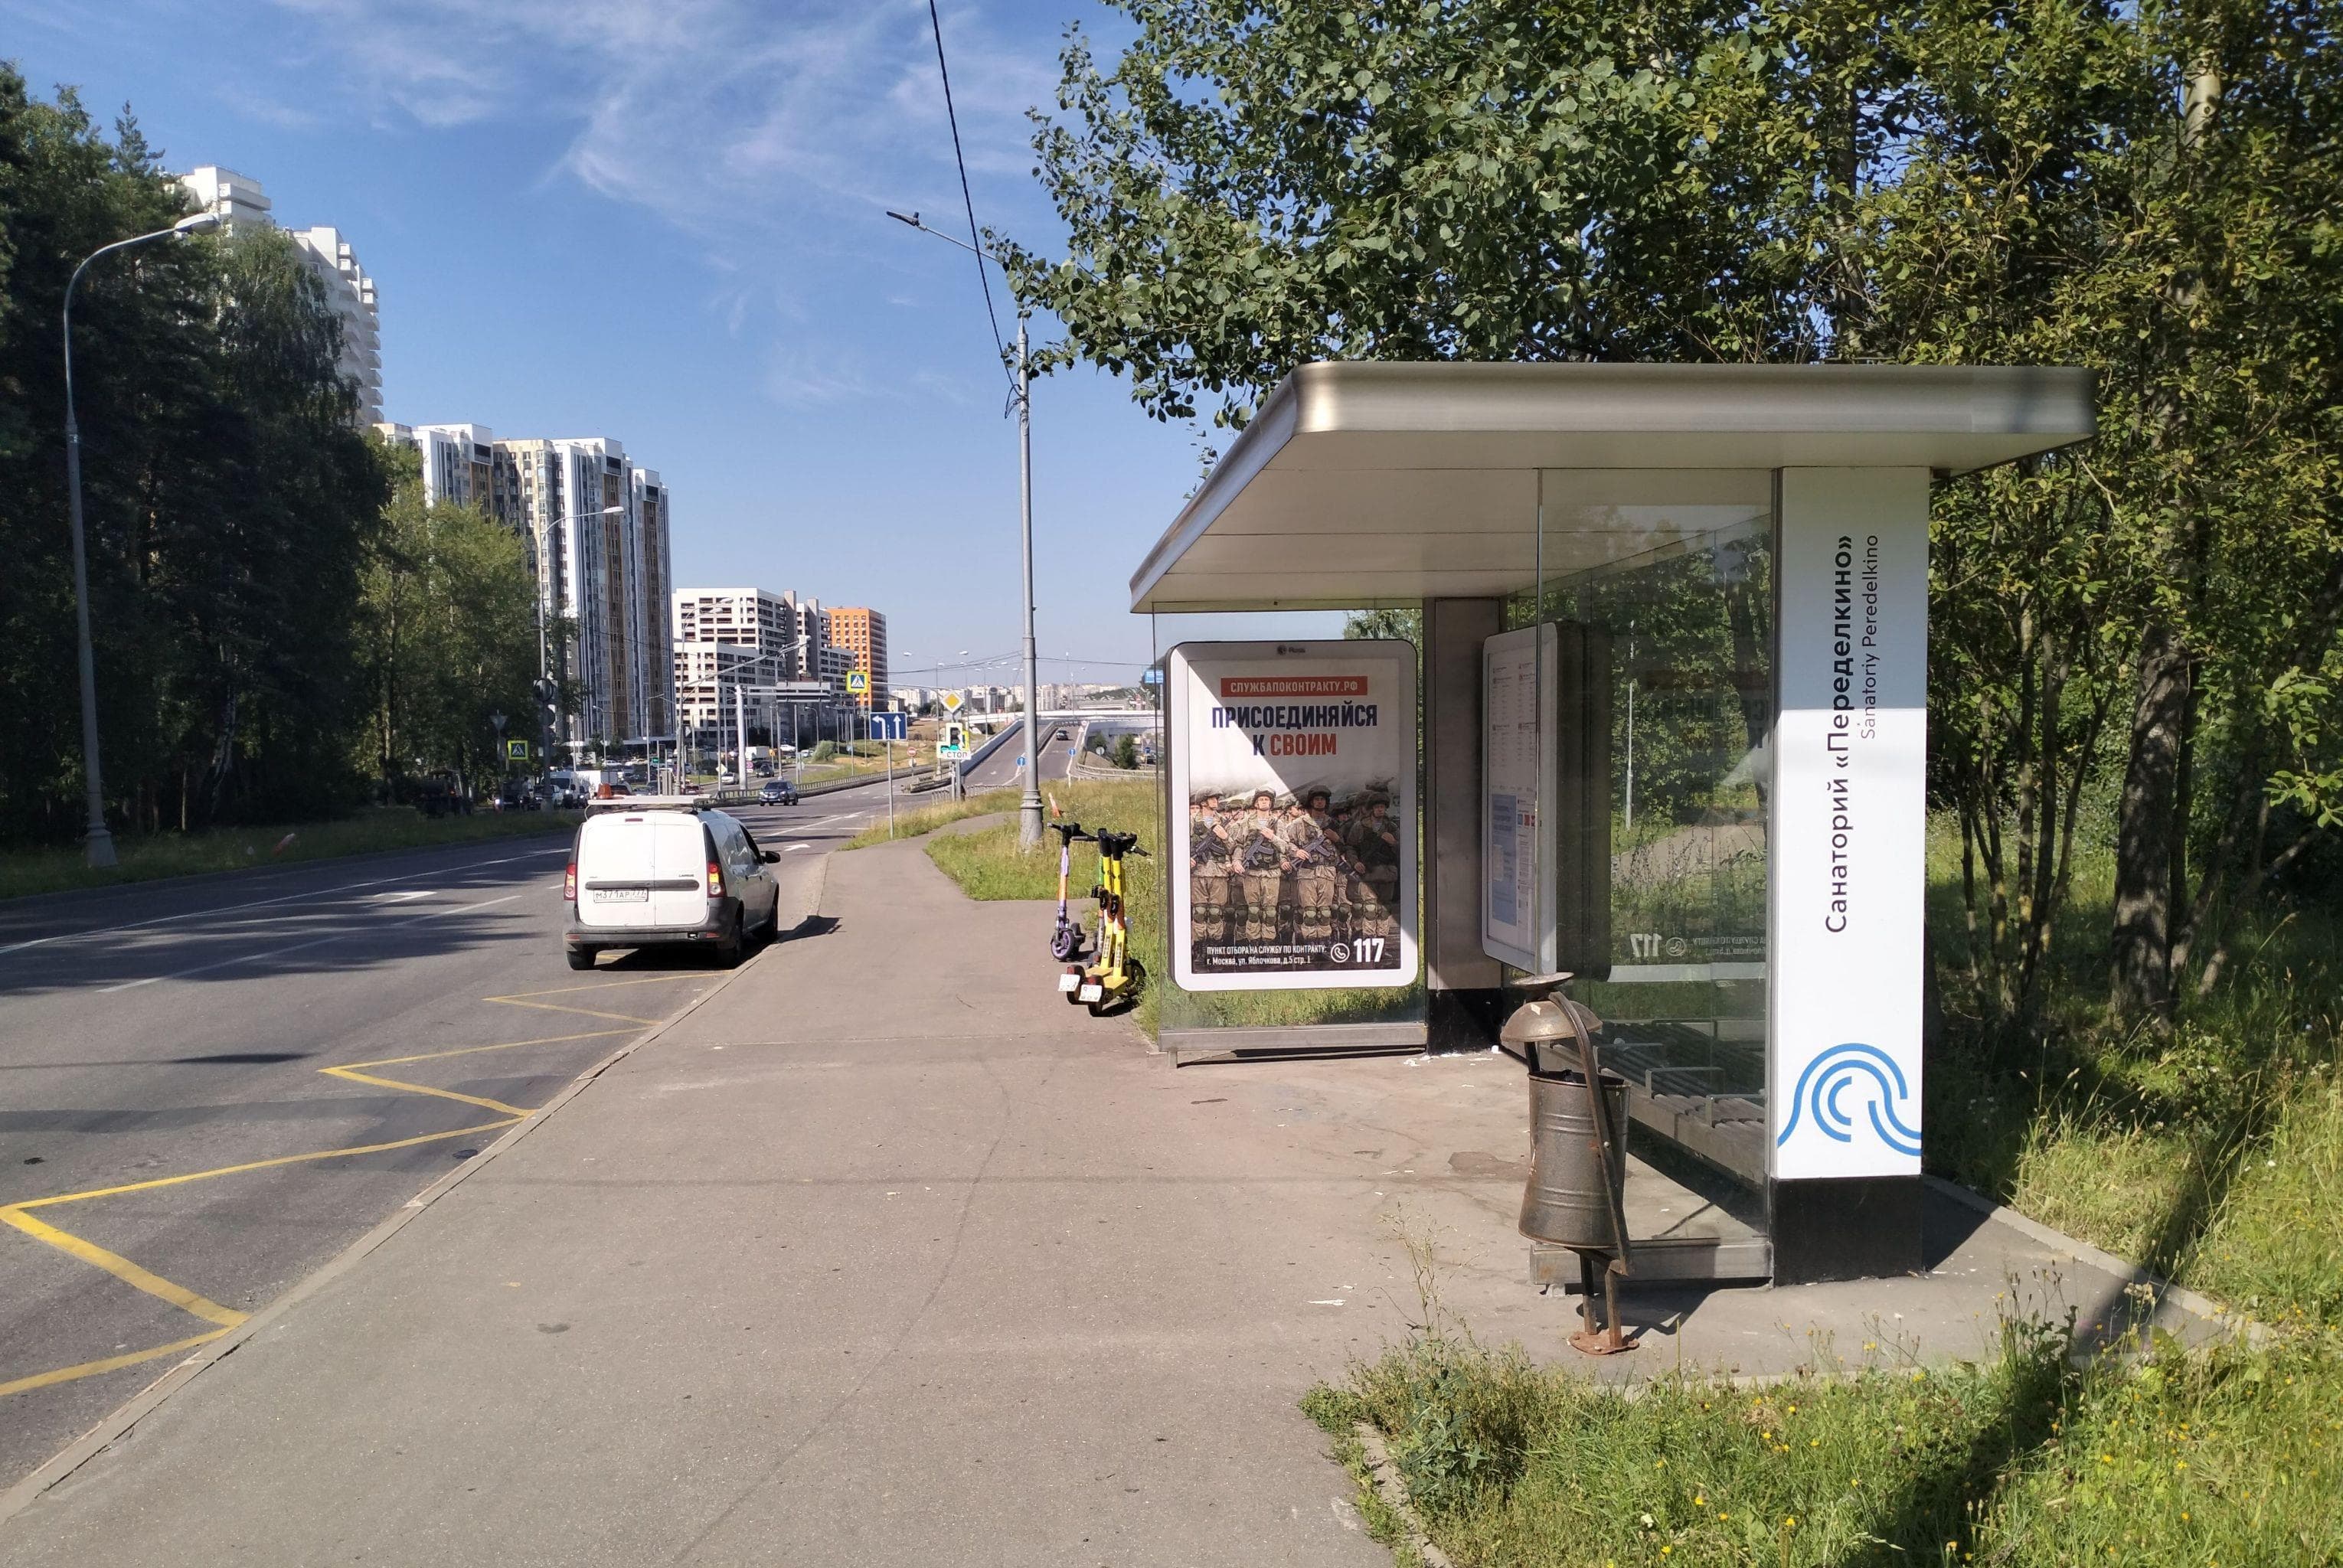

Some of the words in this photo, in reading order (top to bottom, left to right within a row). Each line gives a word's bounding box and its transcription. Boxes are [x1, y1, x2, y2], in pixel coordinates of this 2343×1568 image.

[1861, 535, 1878, 647] Peredelkino
[1827, 535, 1854, 768] «Переделкино»
[1230, 681, 1358, 693] СЛУЖБАПОКОНТРАКТУ.РФ
[1861, 653, 1880, 739] Sanatoriy
[1212, 700, 1377, 730] ПРИСОЕДИНЯЙСЯ
[1253, 734, 1266, 756] К
[1270, 733, 1337, 756] СВОИМ
[1825, 779, 1854, 933] Санаторий
[1207, 946, 1226, 955] ПУНКТ
[1227, 946, 1249, 955] ОТБОРА
[1250, 946, 1258, 955] НА
[1258, 946, 1283, 954] СЛУЖБУ
[1283, 946, 1292, 954] ПО
[1292, 945, 1327, 953] КОНТРАКТУ:
[1212, 957, 1237, 965] Москва,
[1248, 956, 1283, 965] Яблочкова,
[1353, 938, 1385, 962] 117
